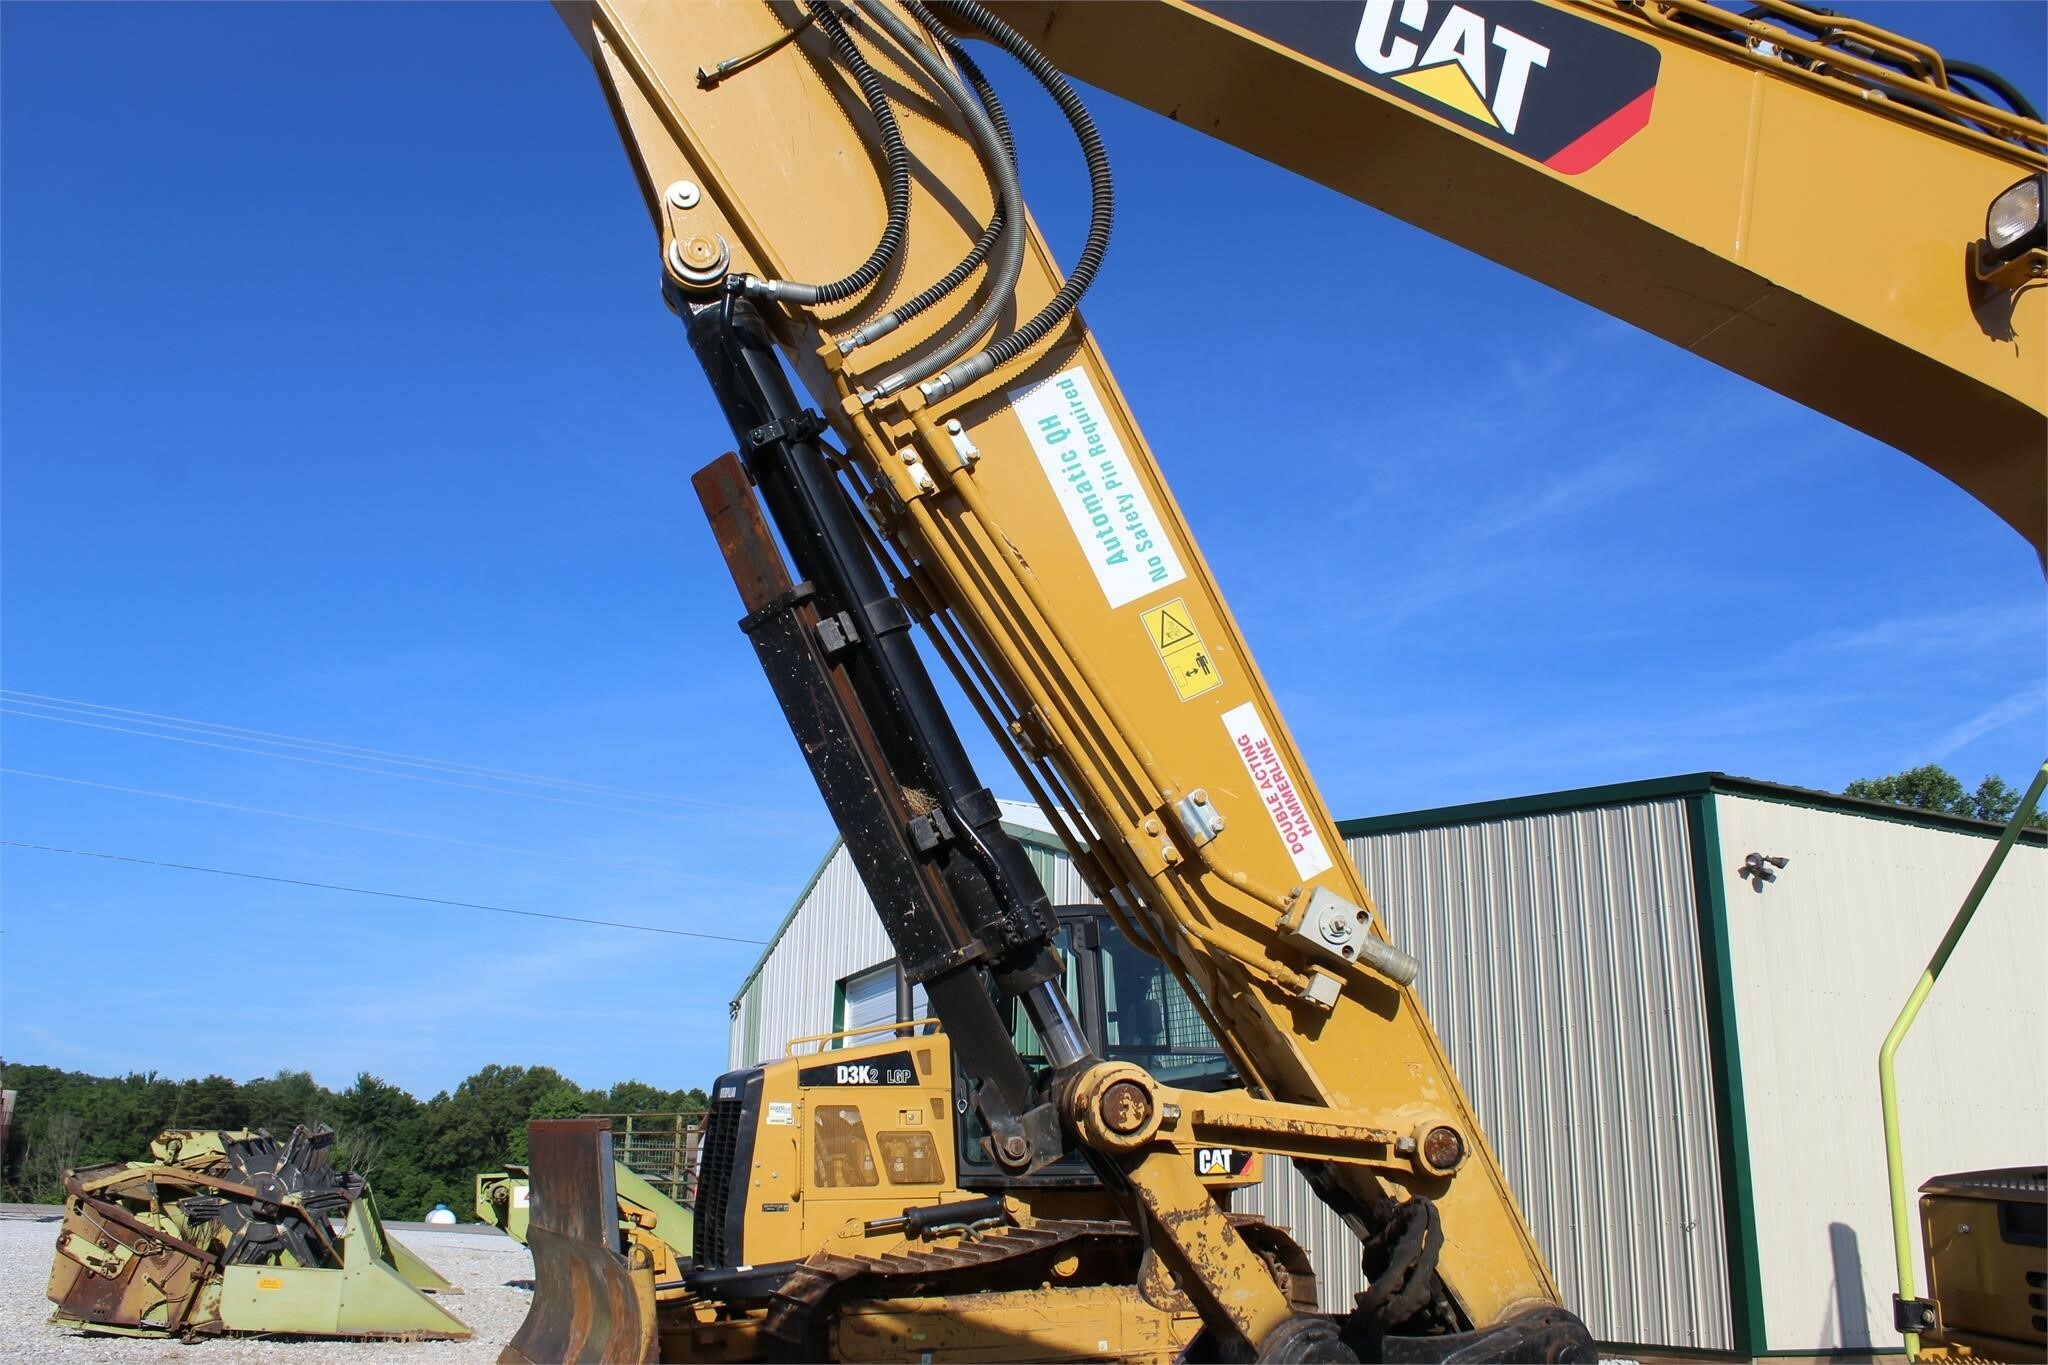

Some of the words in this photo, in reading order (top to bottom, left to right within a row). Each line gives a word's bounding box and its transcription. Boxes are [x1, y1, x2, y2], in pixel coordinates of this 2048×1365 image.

[1355, 0, 1551, 135] CAT
[1038, 414, 1071, 445] QH
[1055, 378, 1106, 458] Required
[1100, 460, 1123, 491] Pin
[1061, 449, 1128, 566] Automatic
[1116, 493, 1153, 553] Safety
[1147, 556, 1169, 583] No
[1237, 734, 1273, 790] ACTING
[1255, 737, 1312, 837] HAMMERLINE
[1266, 793, 1305, 855] DOUBLE
[837, 1065, 879, 1084] D3K2
[886, 1069, 911, 1083] LGP
[1199, 1149, 1232, 1174] CAT
